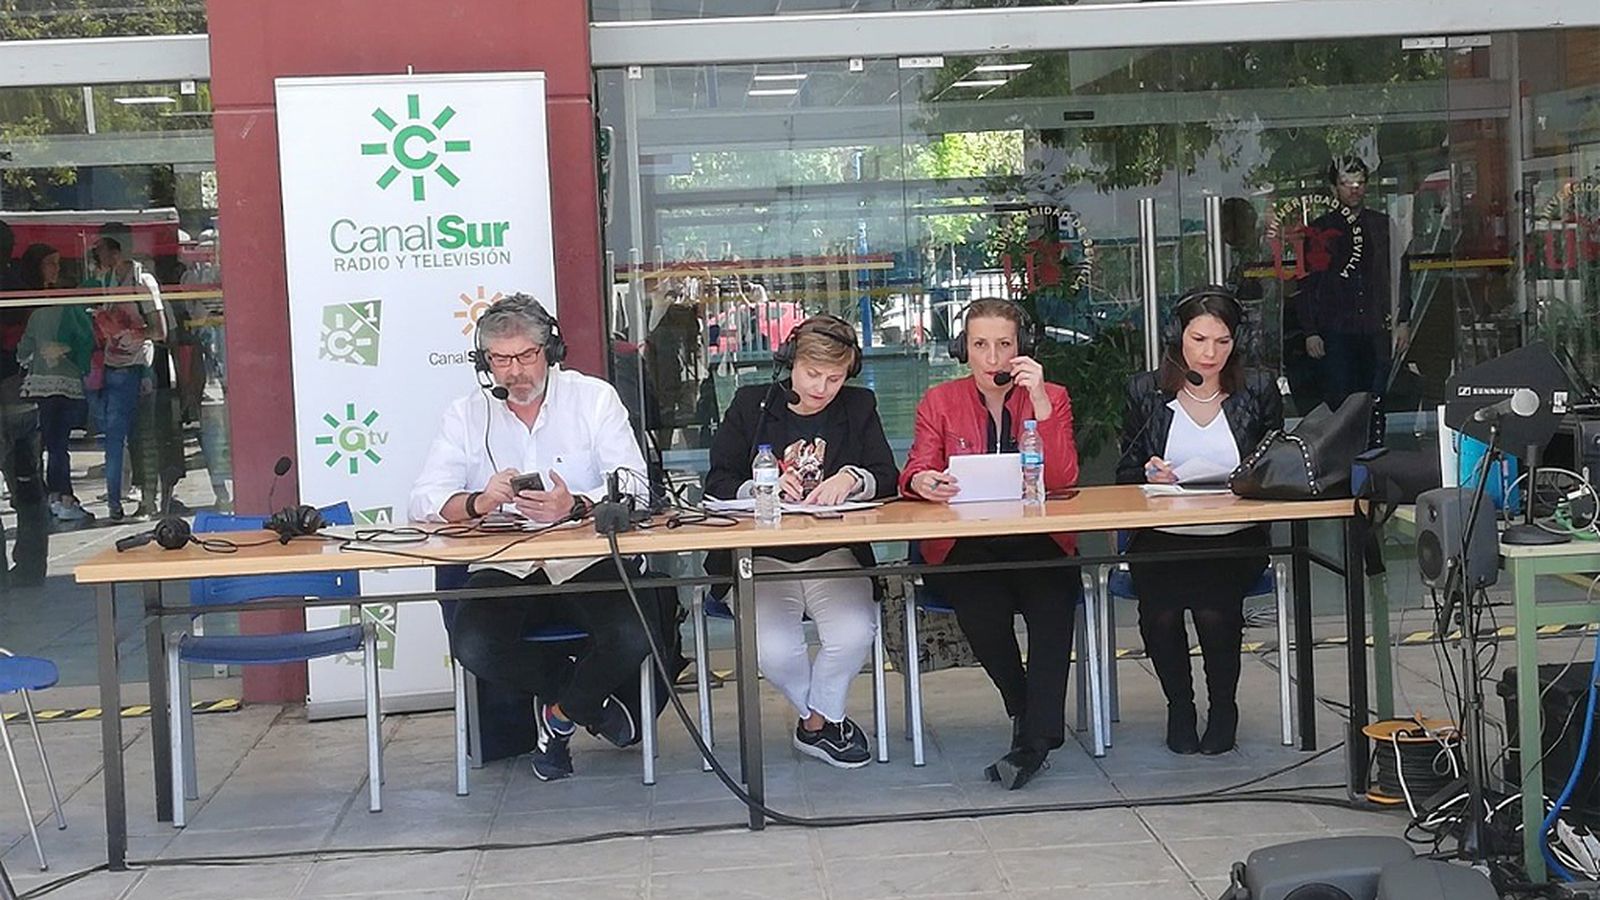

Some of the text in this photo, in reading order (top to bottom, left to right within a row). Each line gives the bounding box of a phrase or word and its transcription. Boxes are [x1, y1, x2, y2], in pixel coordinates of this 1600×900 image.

[1341, 207, 1357, 224] DE
[334, 247, 512, 272] RADIO Y TELEVISIÓN
[1340, 226, 1364, 279] SEVILLA
[364, 303, 378, 321] 1
[1472, 387, 1531, 395] SENNHEIS
[379, 603, 396, 626] 2
